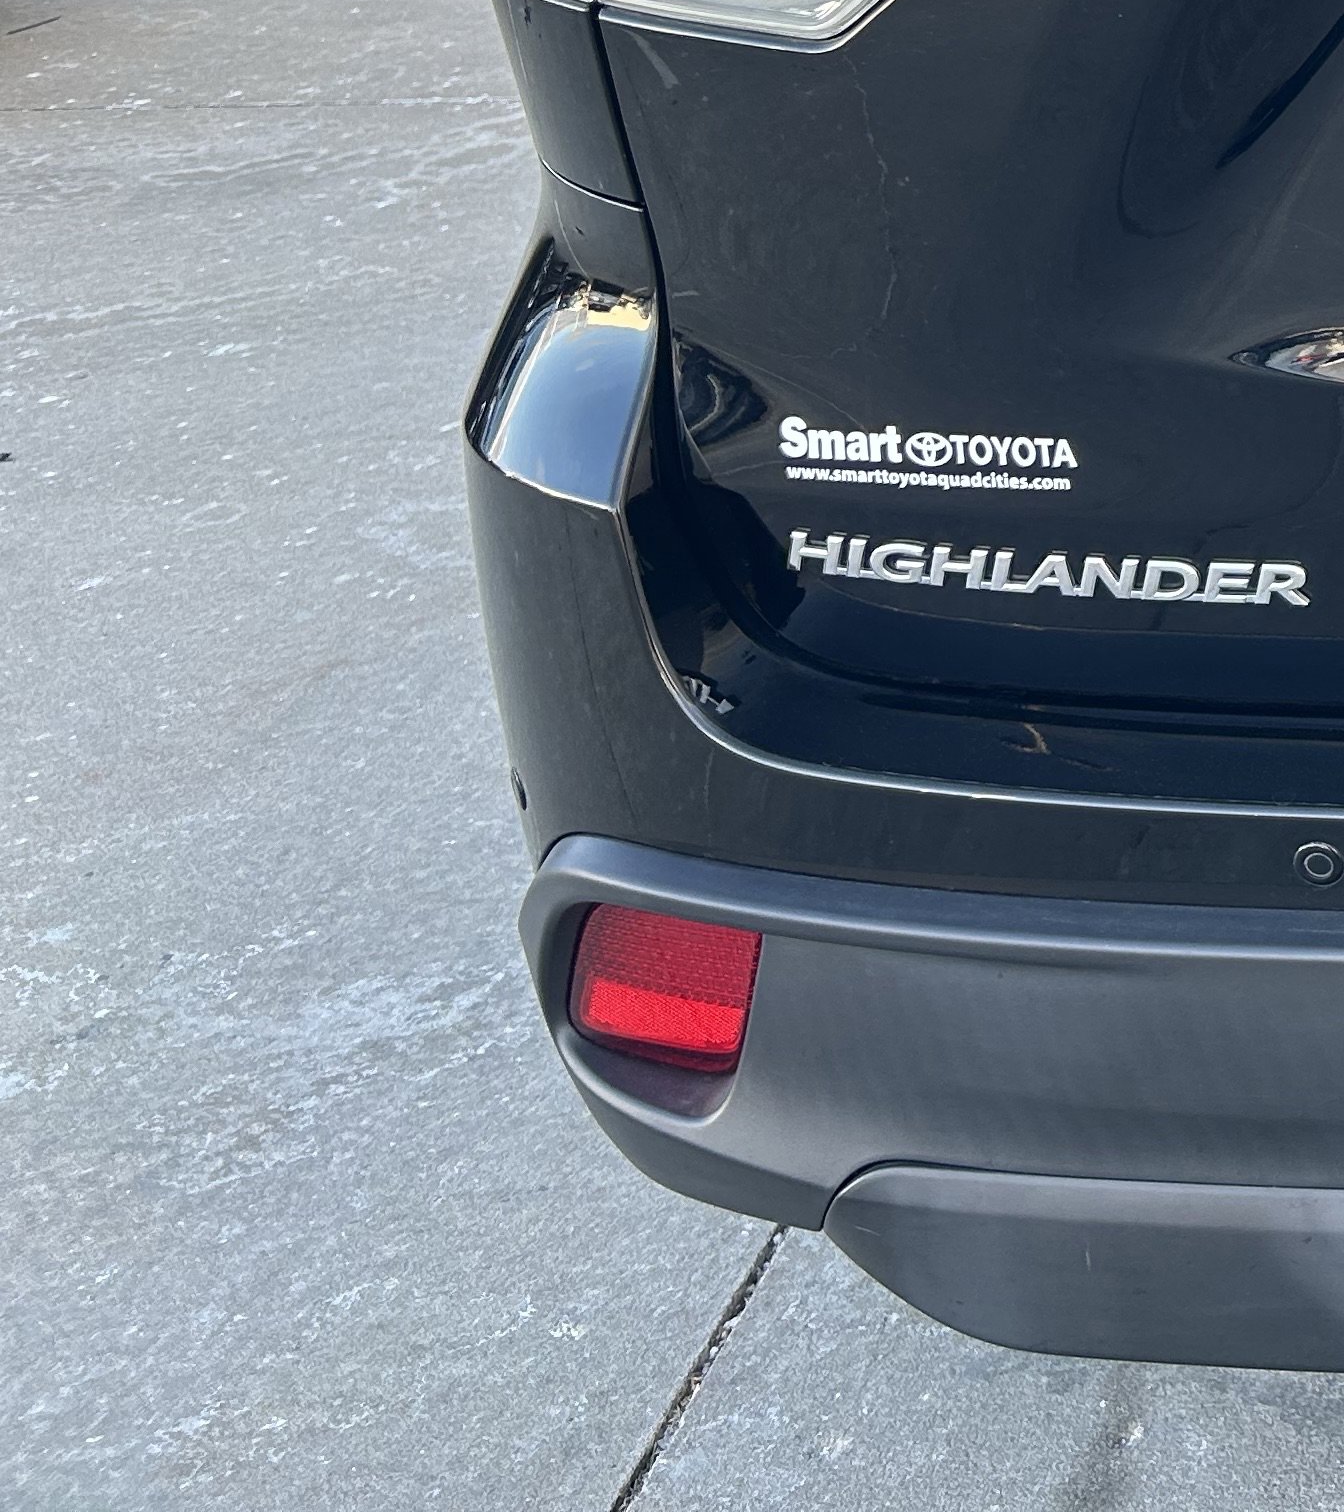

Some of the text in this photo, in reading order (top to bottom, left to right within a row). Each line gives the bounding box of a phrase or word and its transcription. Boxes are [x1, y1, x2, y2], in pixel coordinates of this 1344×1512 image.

[779, 415, 1079, 470] Smart TOYOTA
[785, 463, 1072, 491] www.smarttoyotaquadcities.com
[786, 529, 1310, 606] HIGHLANDER
